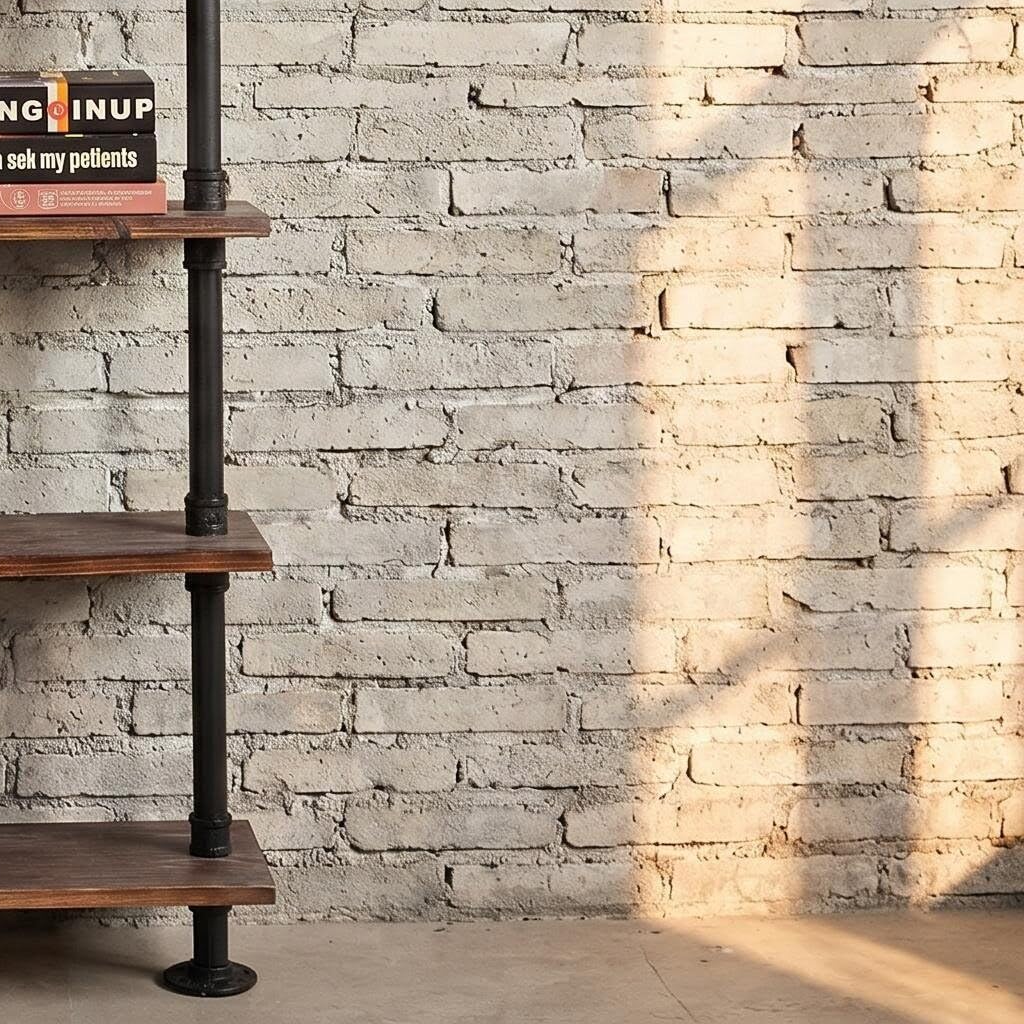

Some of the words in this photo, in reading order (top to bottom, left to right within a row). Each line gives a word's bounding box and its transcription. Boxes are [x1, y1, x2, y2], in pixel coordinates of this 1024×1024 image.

[72, 98, 153, 120] INUP
[7, 148, 36, 170] sek
[40, 152, 66, 174] my
[69, 147, 138, 174] petients
